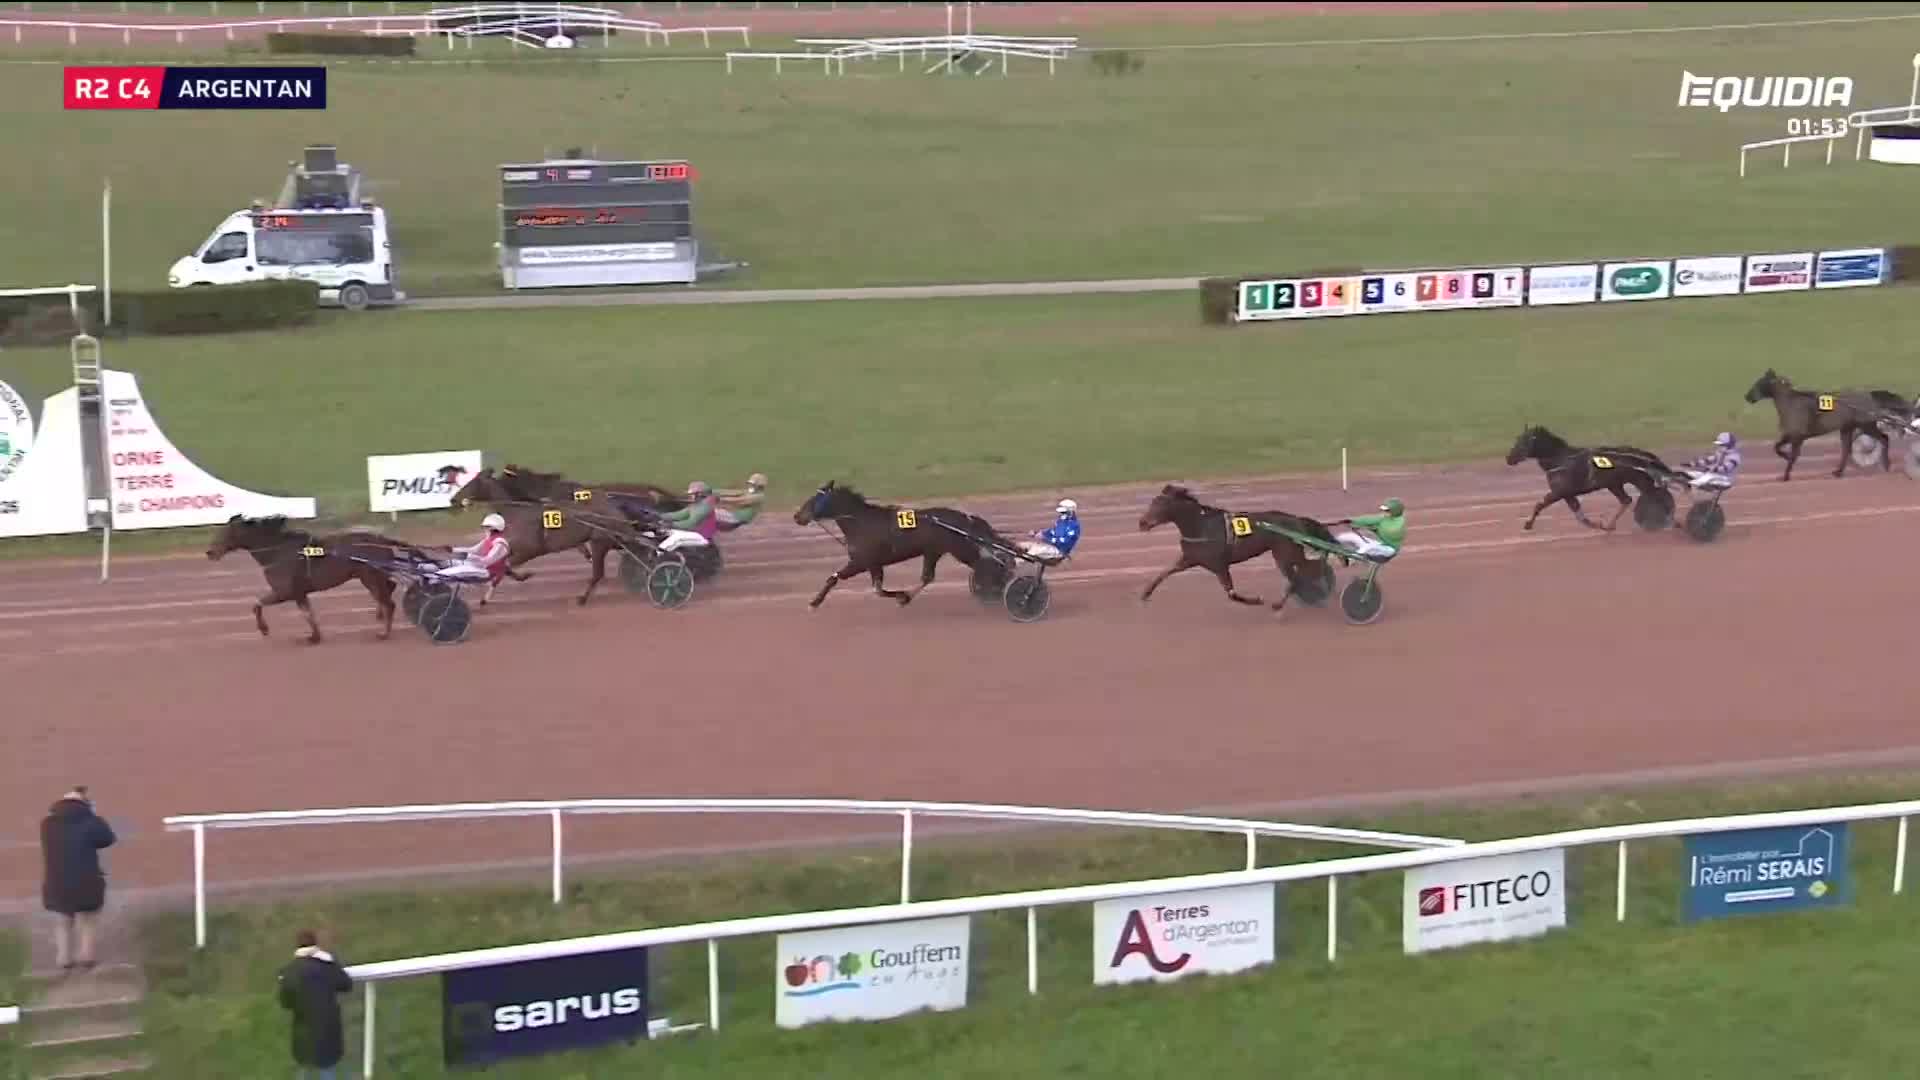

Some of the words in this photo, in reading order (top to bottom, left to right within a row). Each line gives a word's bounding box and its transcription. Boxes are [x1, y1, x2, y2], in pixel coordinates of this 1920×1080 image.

[1251, 289, 1262, 305] 1
[1278, 286, 1292, 305] 2
[1304, 284, 1318, 302] 3
[1331, 284, 1344, 299] 4
[1365, 282, 1380, 299] 5
[1393, 280, 1406, 297] 6
[1420, 278, 1434, 295] 7
[1447, 277, 1460, 294] 8
[1476, 276, 1490, 293] 9
[1503, 276, 1515, 292] T
[112, 451, 164, 467] ORNE
[381, 475, 436, 497] PMU
[140, 493, 225, 513] CHAMPIONS
[543, 512, 560, 527] 16
[898, 513, 915, 527] 15
[1236, 520, 1247, 533] 9
[1700, 864, 1752, 886] Rémi
[1756, 857, 1825, 881] SERAIS
[1453, 870, 1551, 911] FITECO
[1154, 904, 1210, 923] Terres
[1162, 919, 1259, 942] d'Argentan
[869, 943, 961, 969] Gouffern
